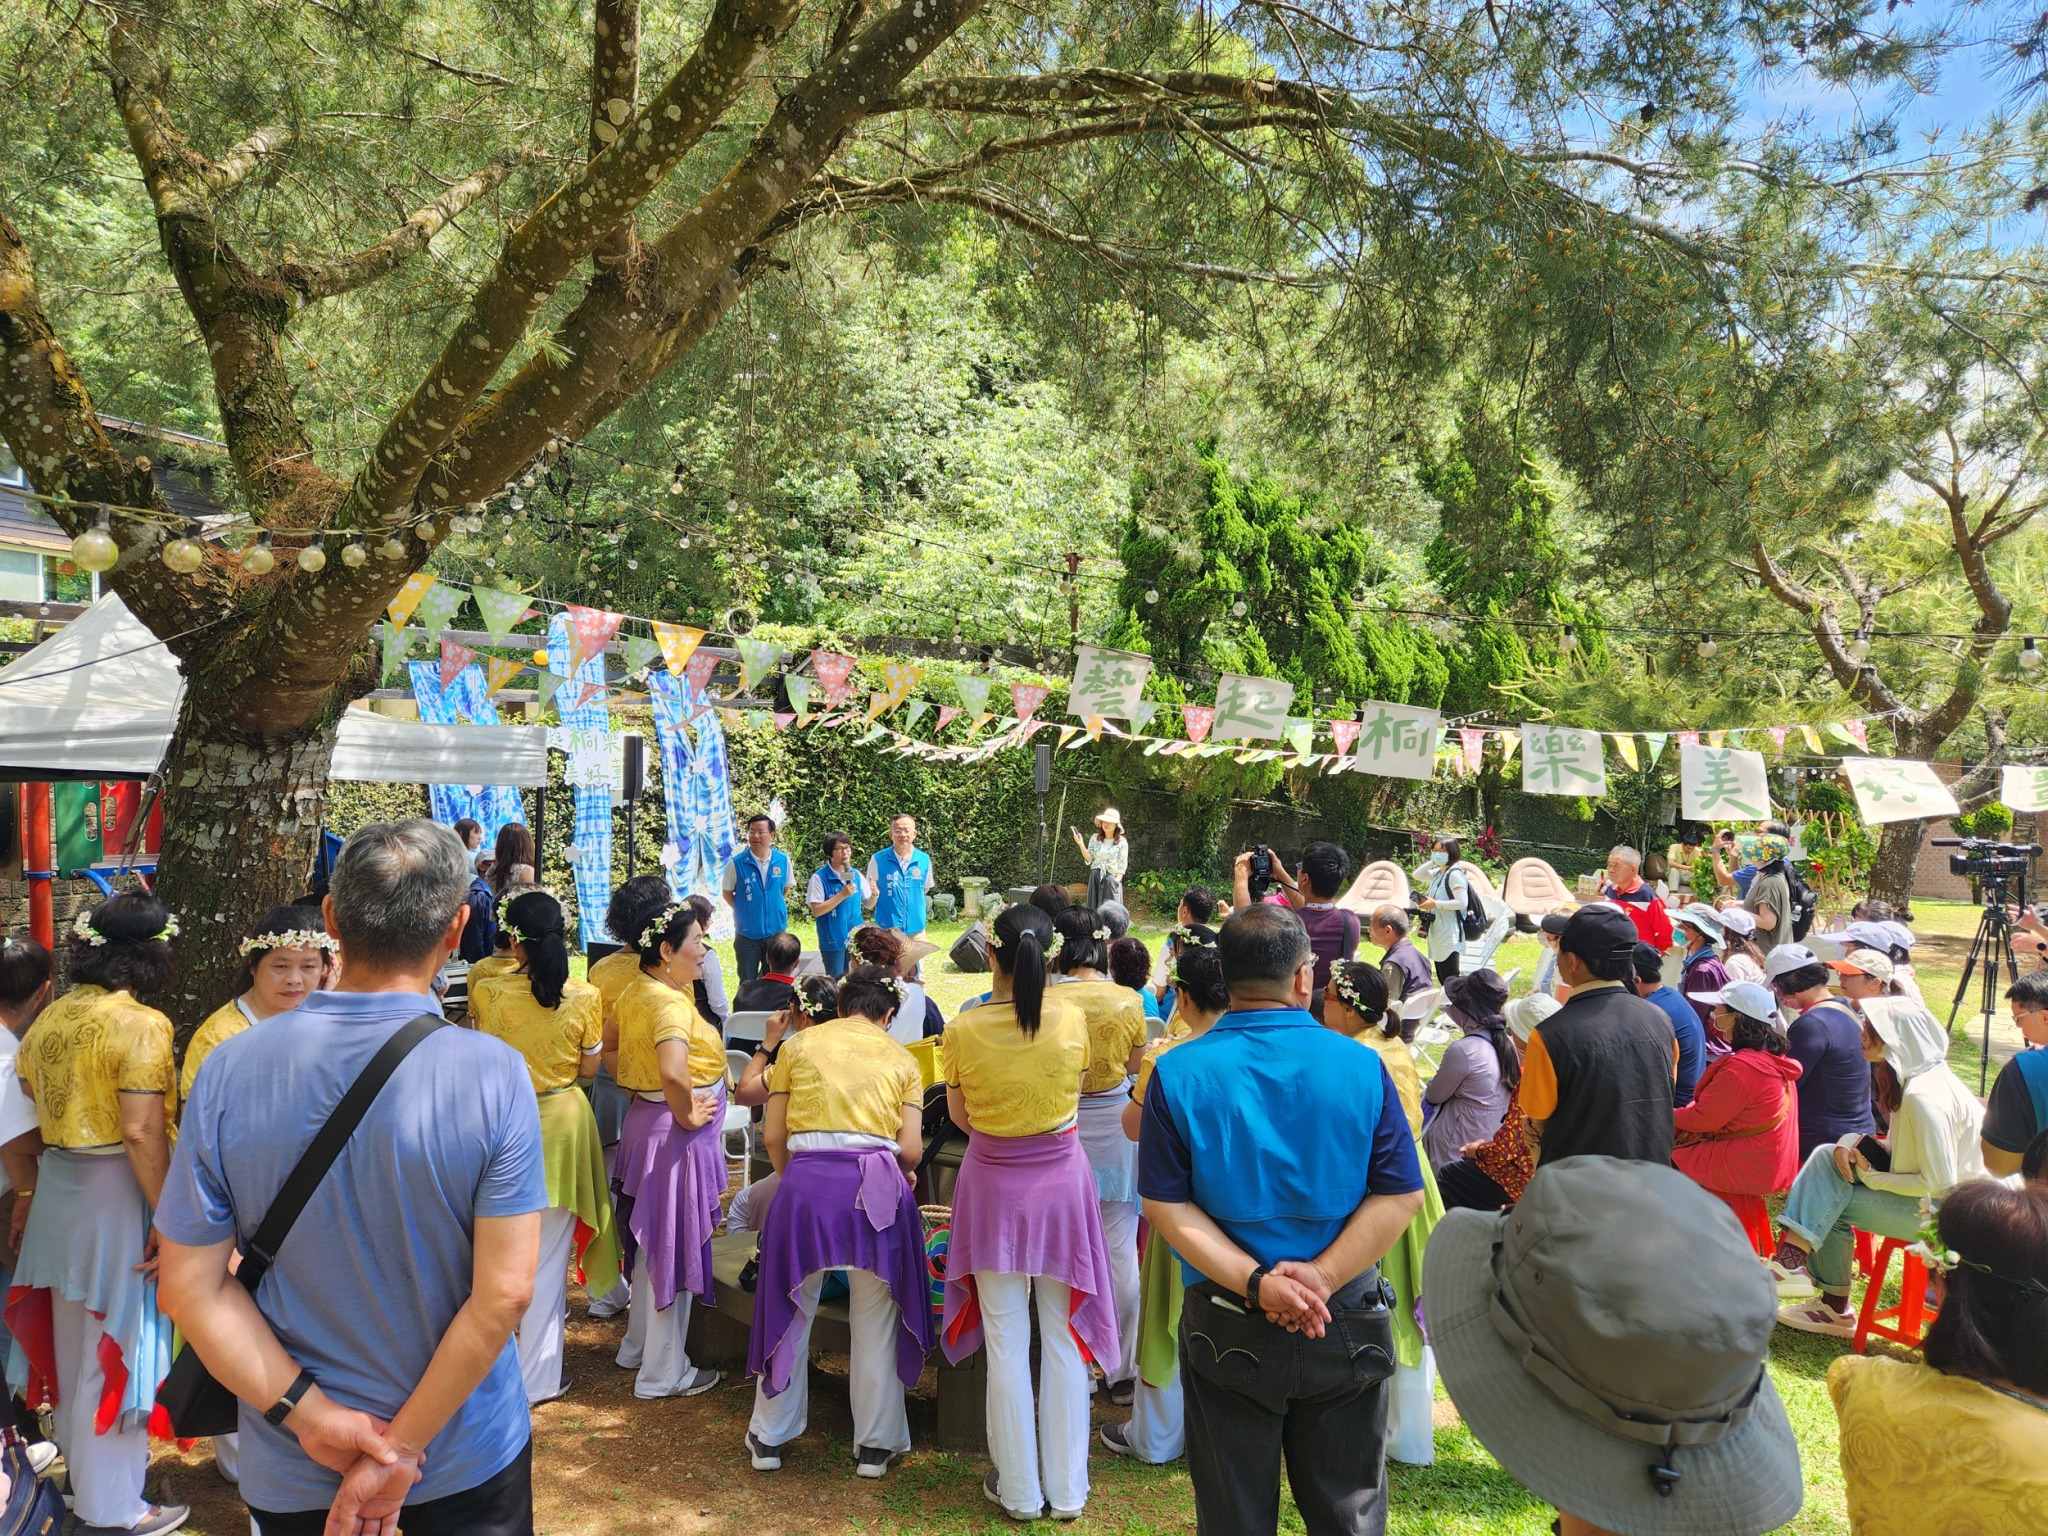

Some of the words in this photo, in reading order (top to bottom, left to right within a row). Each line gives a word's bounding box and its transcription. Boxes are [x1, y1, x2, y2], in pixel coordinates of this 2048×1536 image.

[1078, 650, 1137, 718] 藝
[1215, 679, 1286, 730] 起
[1359, 707, 1431, 761] 桐
[1528, 725, 1603, 789] 樂
[1694, 749, 1764, 819] 美
[1855, 766, 1942, 803] 好
